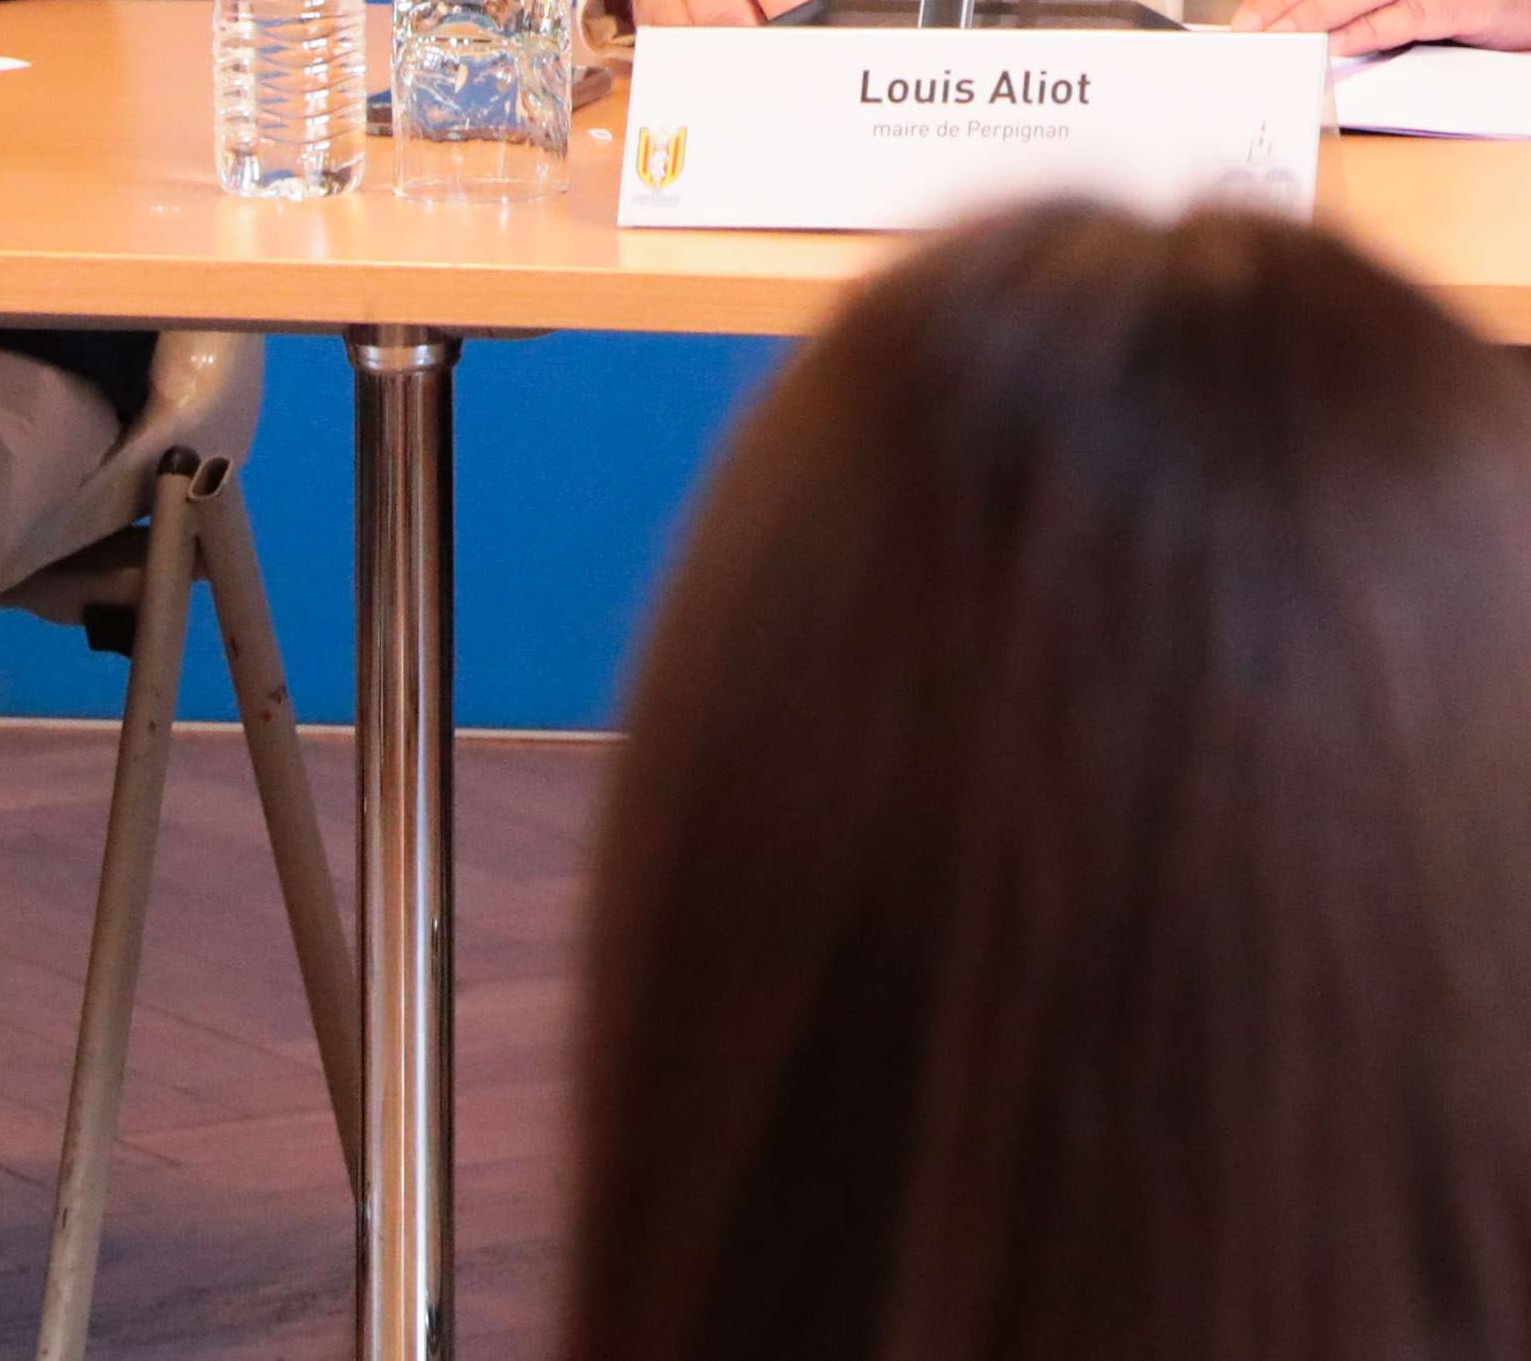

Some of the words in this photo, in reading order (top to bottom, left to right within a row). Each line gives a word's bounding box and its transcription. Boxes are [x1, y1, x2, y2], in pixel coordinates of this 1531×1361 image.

[859, 69, 974, 105] Louis
[988, 69, 1091, 106] Aliot
[873, 121, 929, 139] maire
[936, 120, 960, 139] de
[967, 121, 1070, 143] Perpignan
